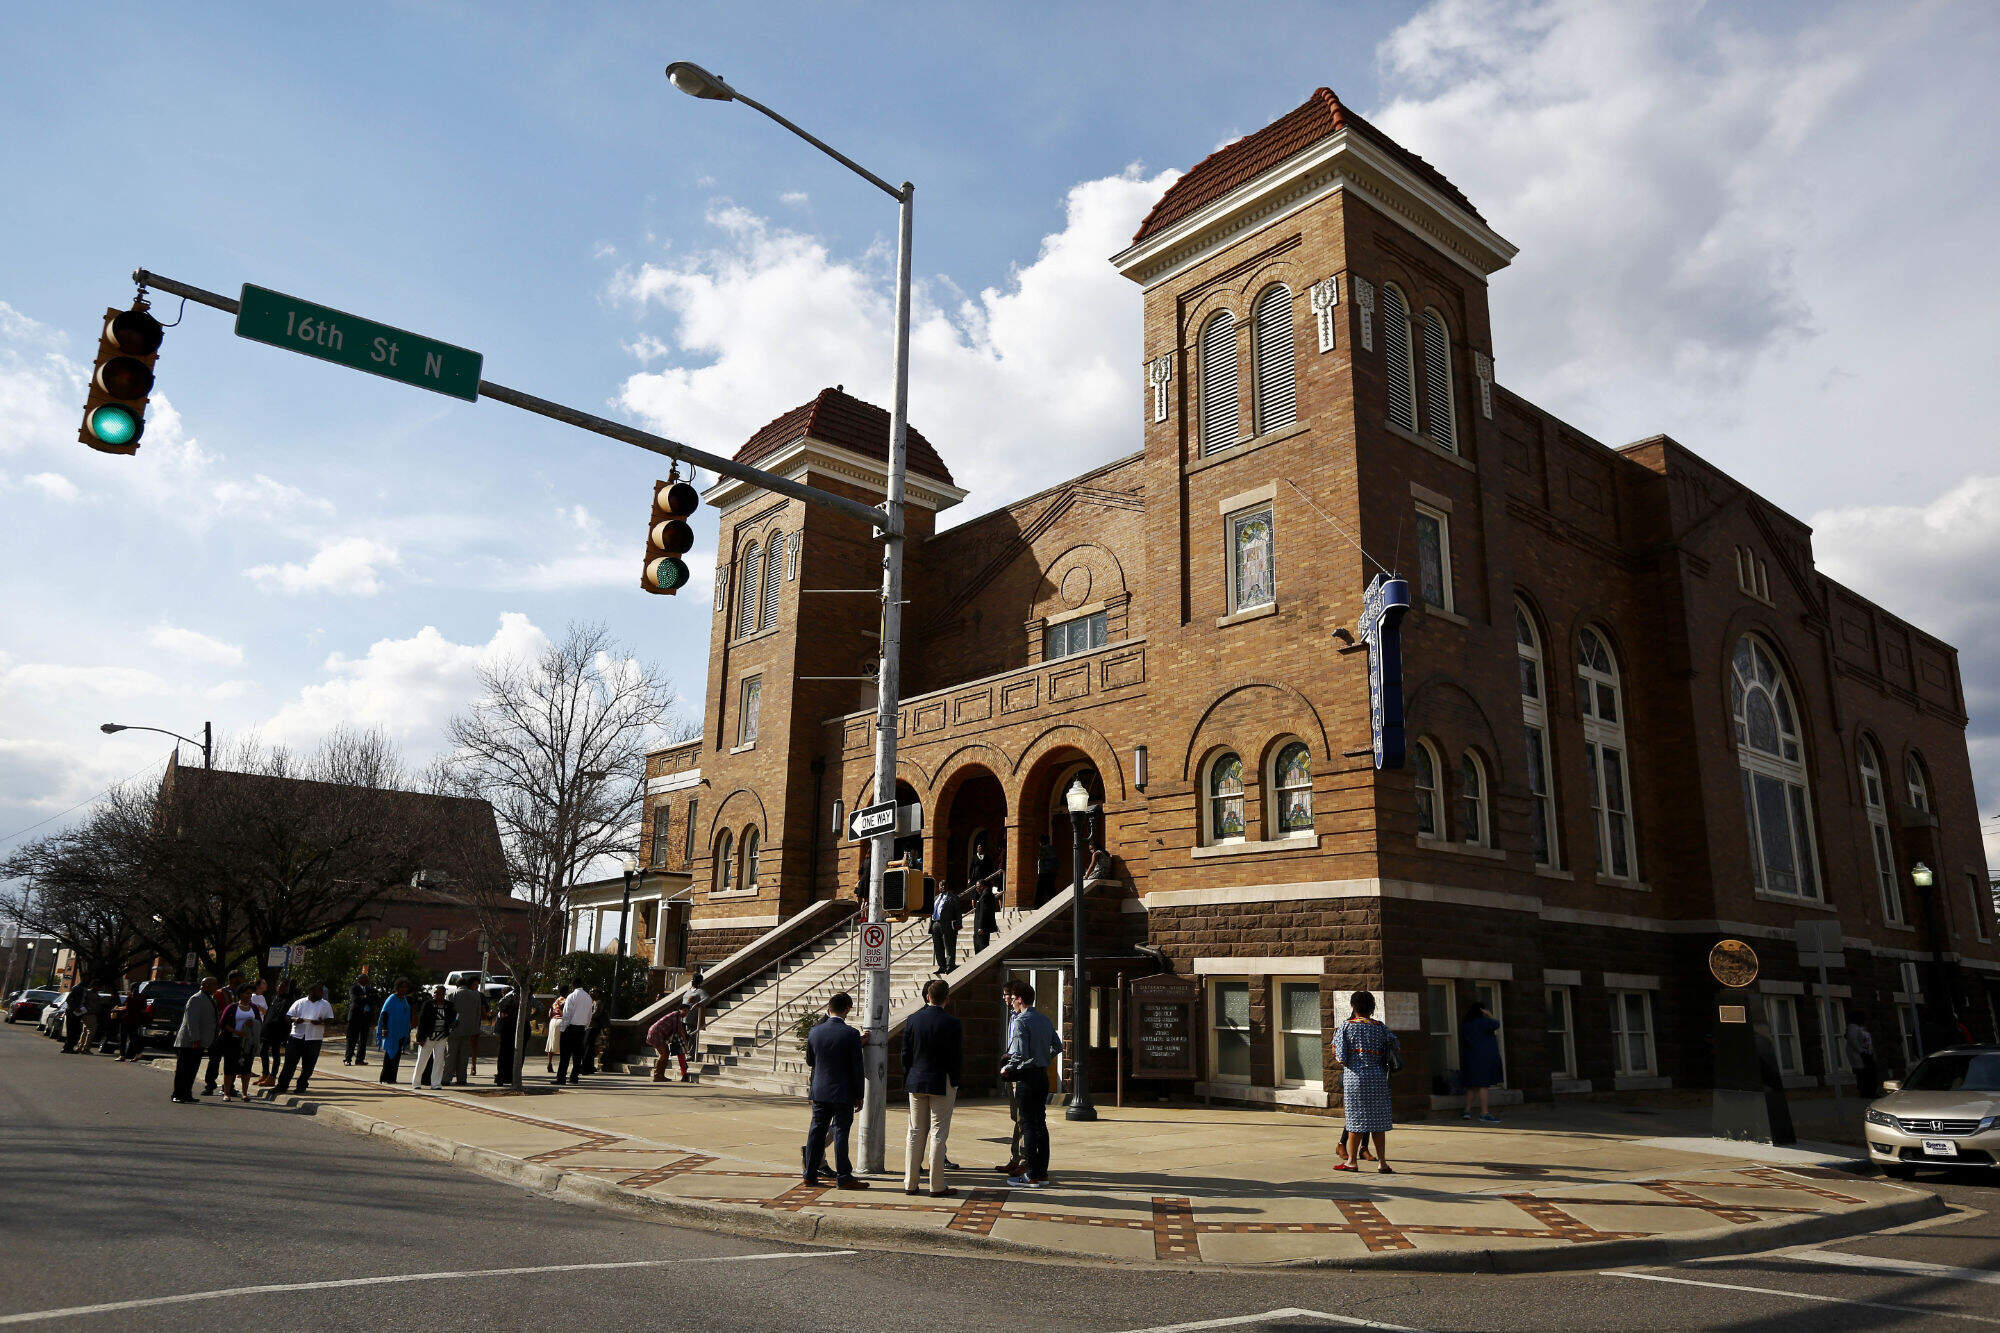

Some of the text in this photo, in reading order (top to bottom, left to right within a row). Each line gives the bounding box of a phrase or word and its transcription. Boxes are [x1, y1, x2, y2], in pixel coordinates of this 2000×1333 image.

[286, 311, 442, 379] 16th St N
[862, 811, 891, 829] ONE WAY
[864, 955, 882, 963] STOP
